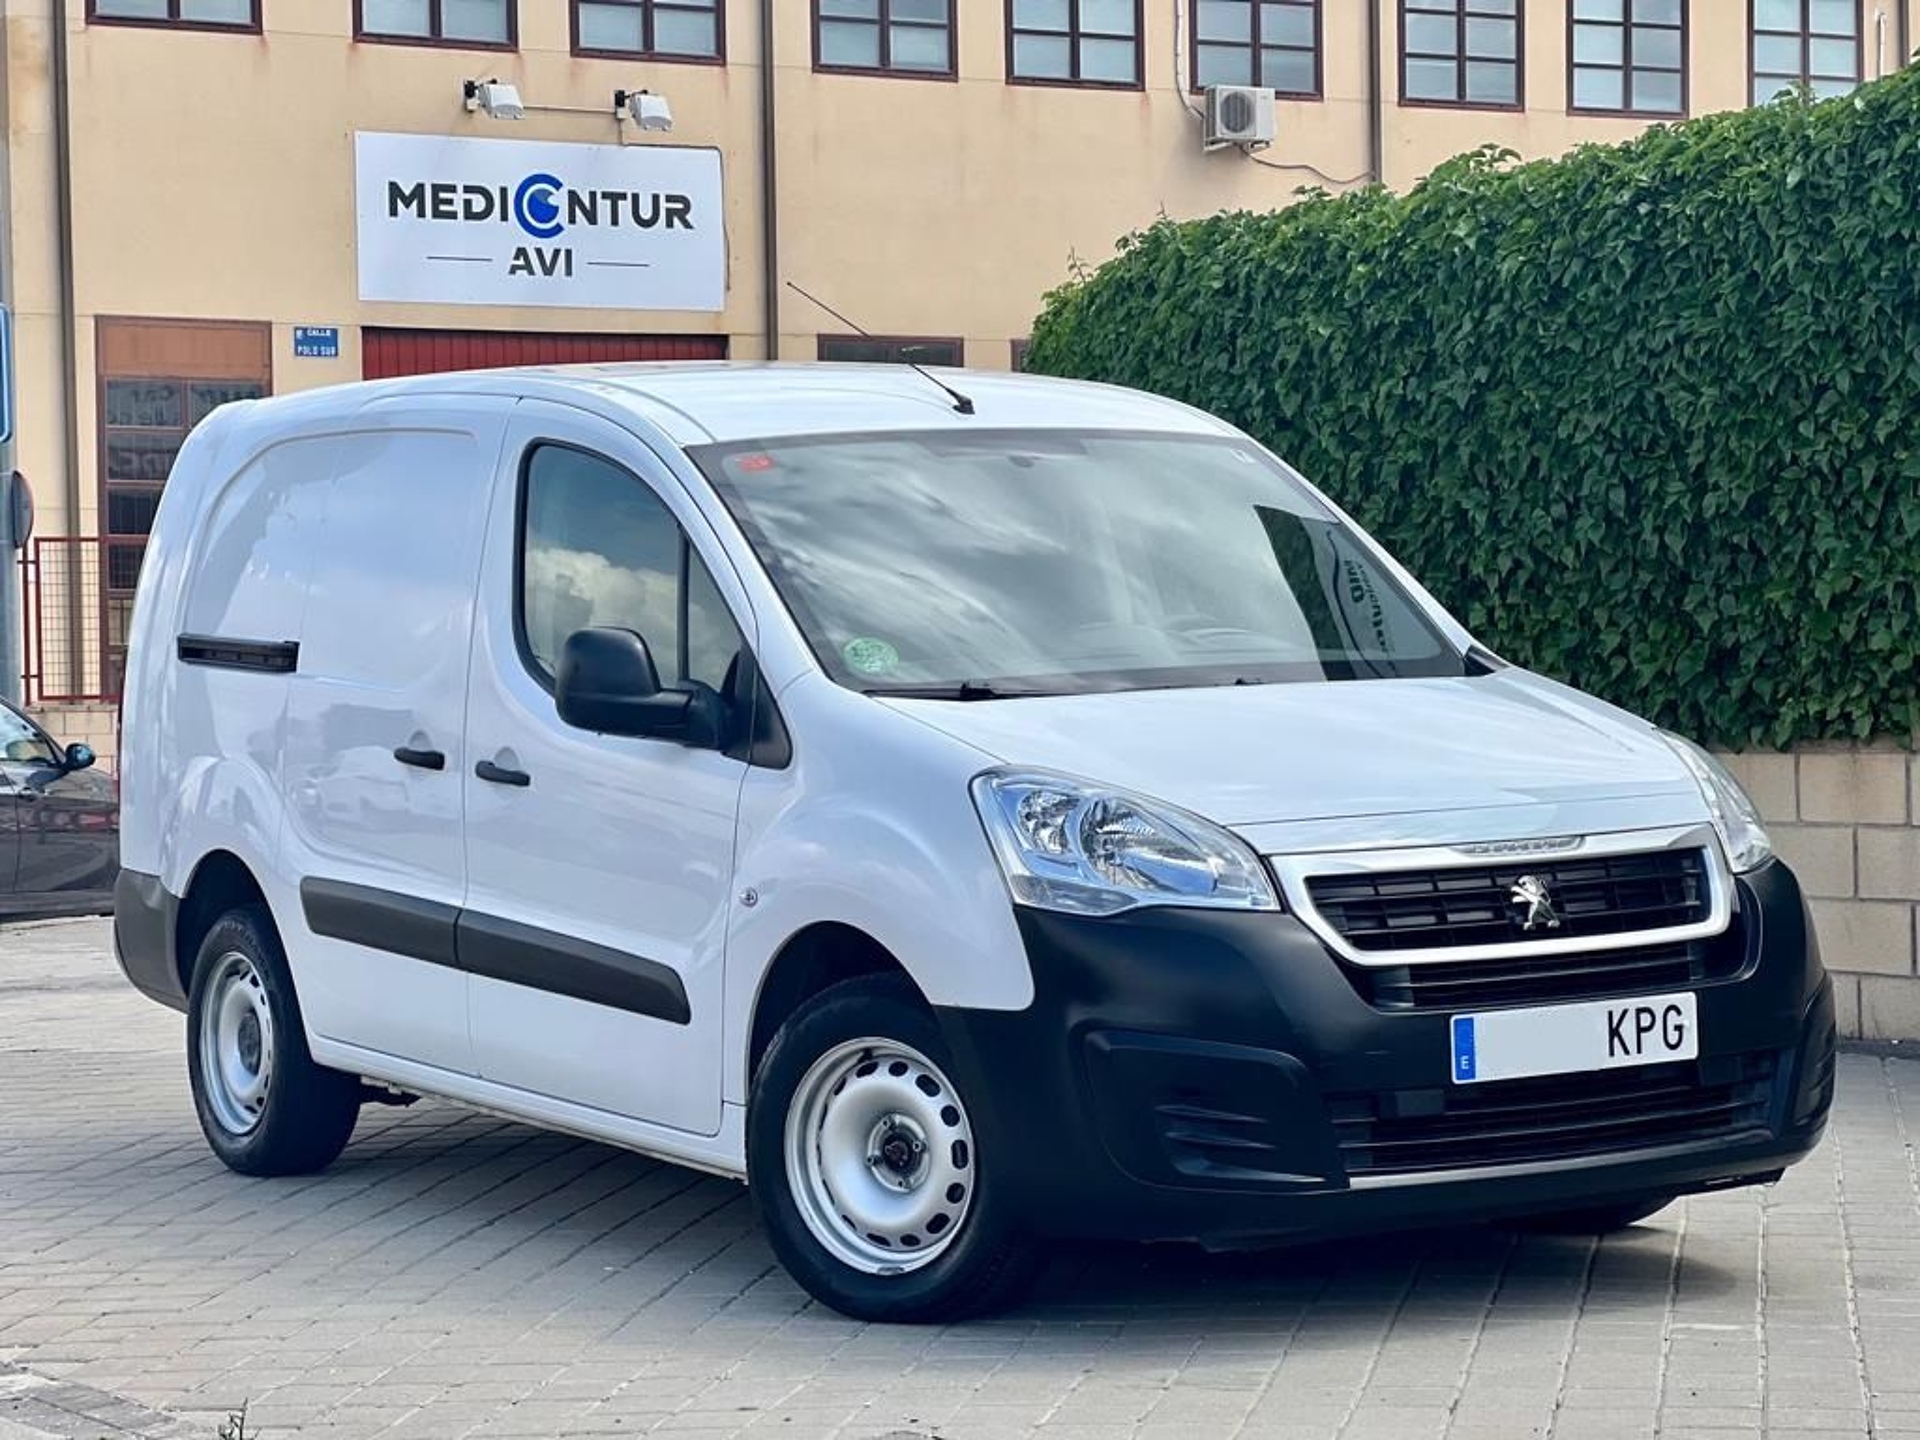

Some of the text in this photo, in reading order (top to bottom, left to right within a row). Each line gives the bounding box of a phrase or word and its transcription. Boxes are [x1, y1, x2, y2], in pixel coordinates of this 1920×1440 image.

[508, 247, 573, 277] AVI
[1608, 1004, 1684, 1057] KPG
[1461, 1056, 1470, 1069] E
